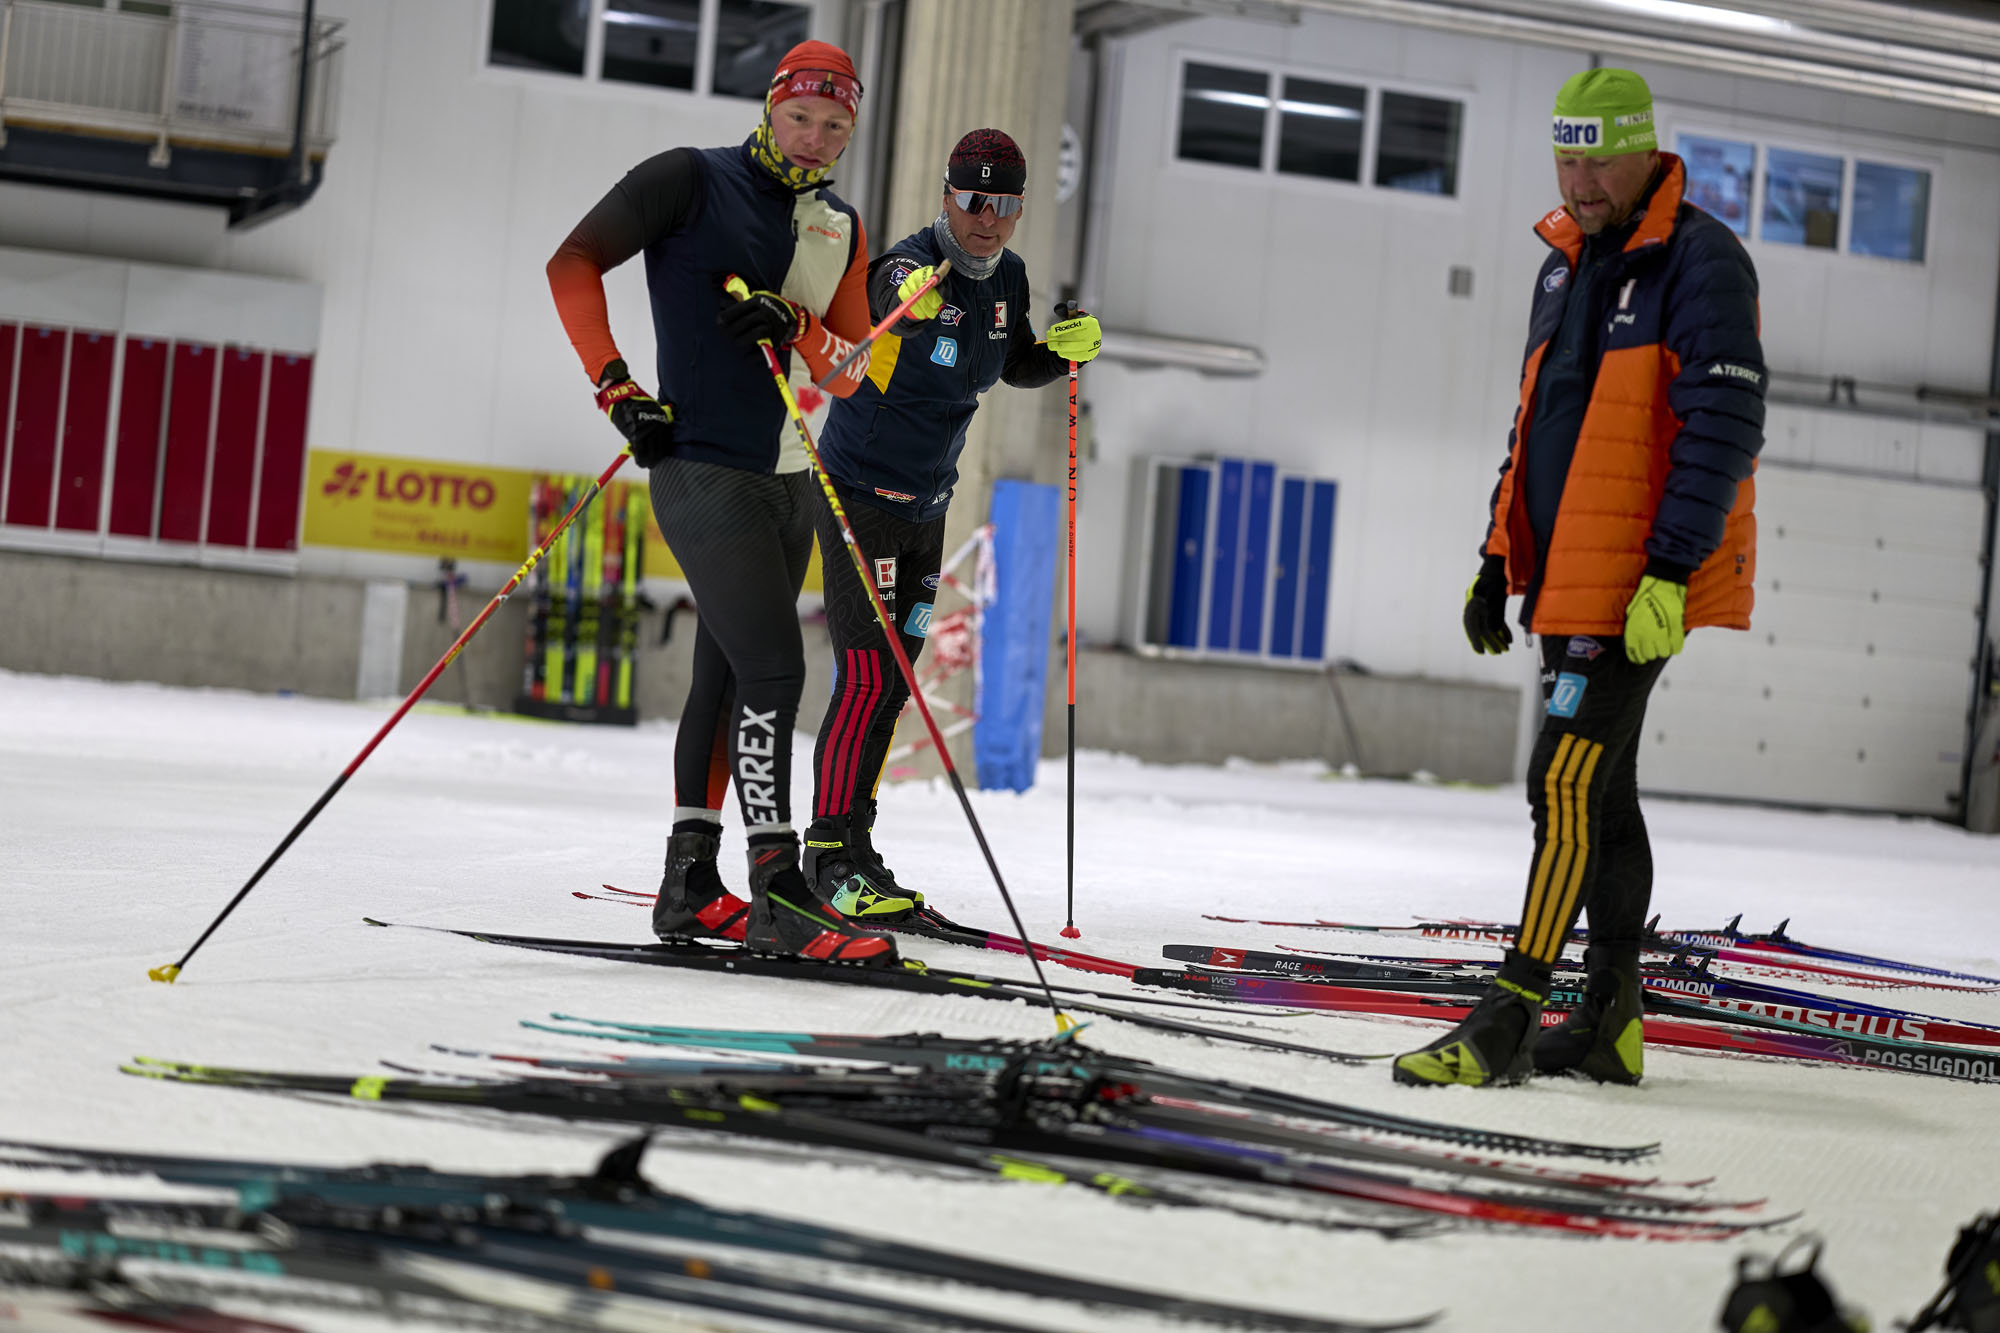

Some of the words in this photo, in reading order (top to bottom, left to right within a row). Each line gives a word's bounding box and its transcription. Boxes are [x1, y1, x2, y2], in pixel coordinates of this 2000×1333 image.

[981, 166, 991, 178] D
[1055, 321, 1082, 333] Roeckl
[939, 341, 955, 363] TQ
[1724, 363, 1761, 384] TERREX
[606, 383, 639, 400] LEKI
[376, 467, 497, 513] LOTTO
[1274, 959, 1302, 972] RACE
[1303, 963, 1325, 974] PRO
[1211, 975, 1237, 987] WCS
